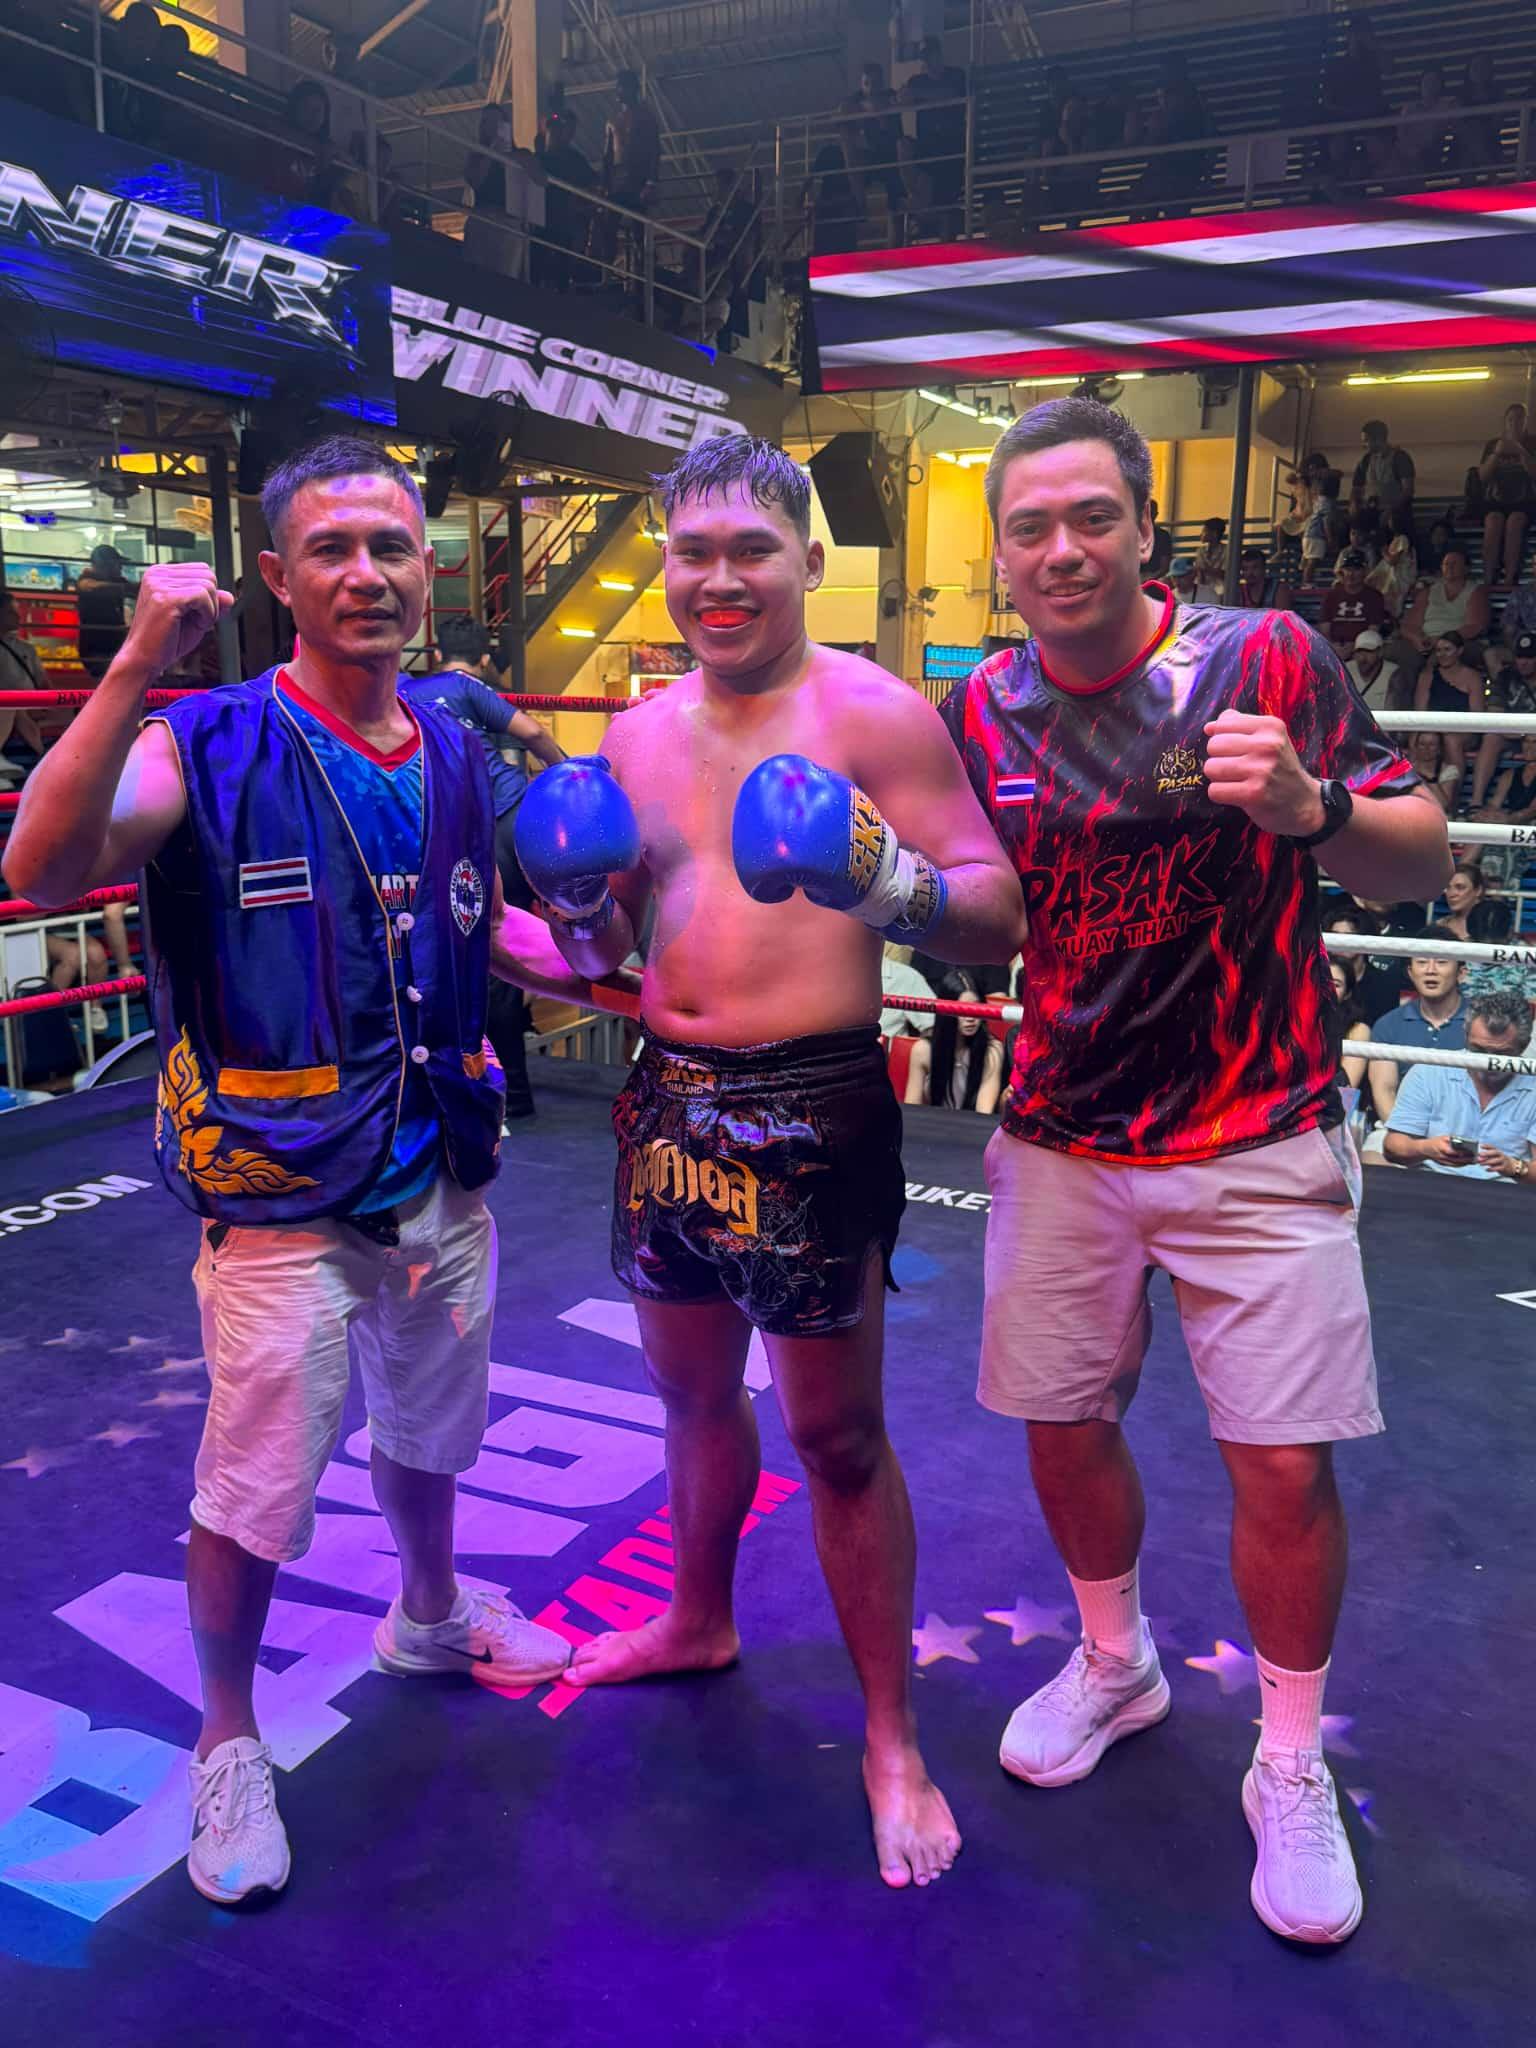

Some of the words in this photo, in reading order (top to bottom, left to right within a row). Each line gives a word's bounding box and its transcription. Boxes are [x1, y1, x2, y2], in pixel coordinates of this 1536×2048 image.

[540, 338, 729, 409] CORNER
[1021, 828, 1221, 938] PASAK
[1053, 928, 1119, 959] MUAY
[1124, 911, 1190, 949] THAI
[1487, 1056, 1536, 1075] BAN
